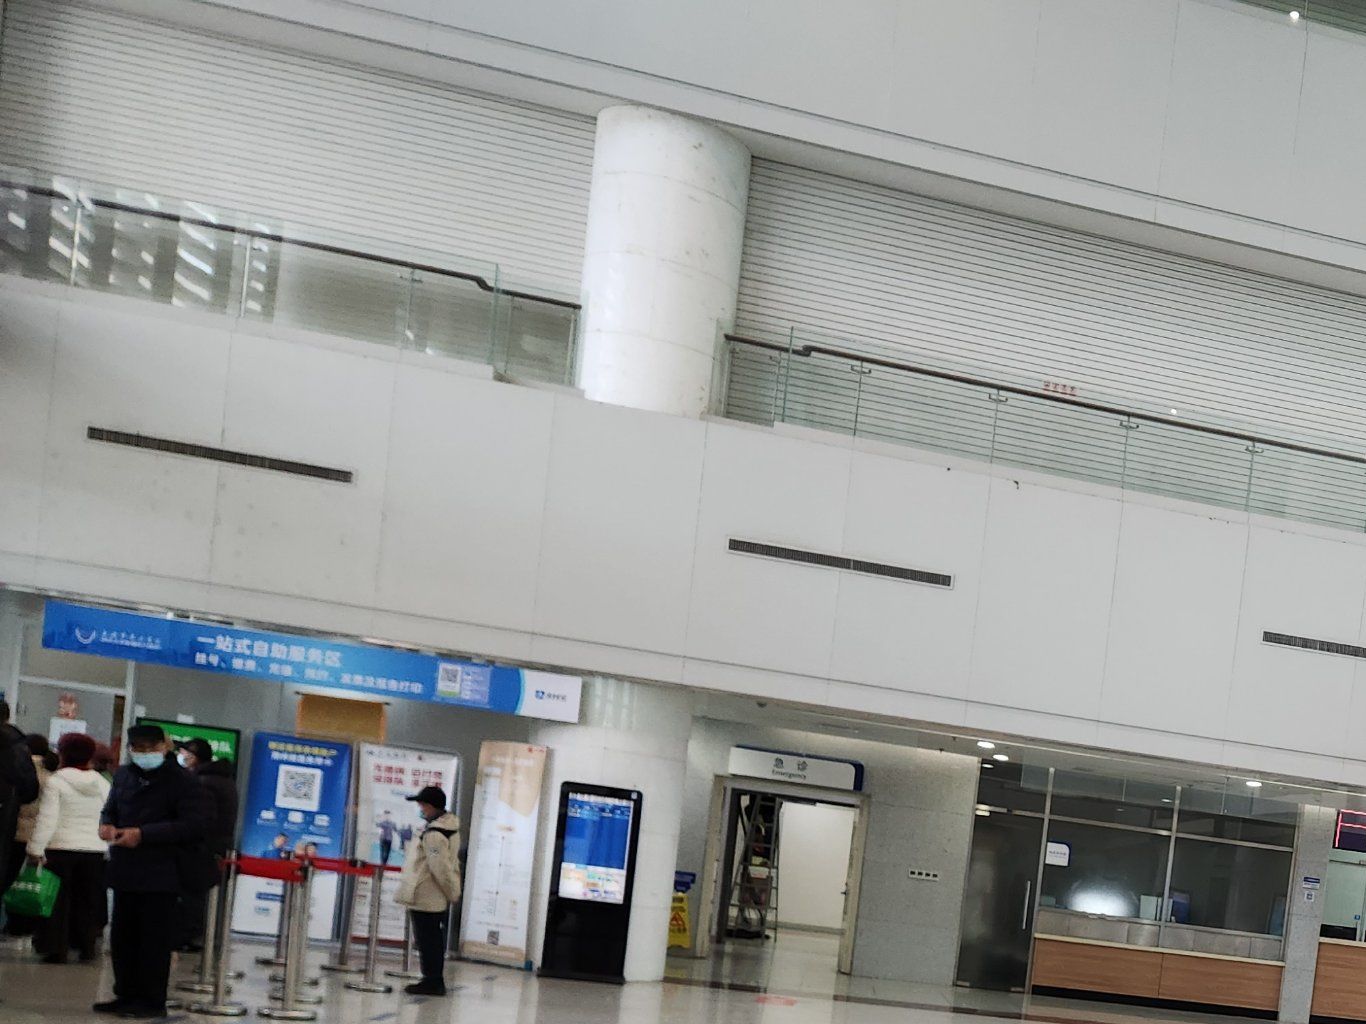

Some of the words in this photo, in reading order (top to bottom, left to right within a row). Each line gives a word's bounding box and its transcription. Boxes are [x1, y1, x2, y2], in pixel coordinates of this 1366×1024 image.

[197, 634, 341, 668] 一站式自助服务区
[773, 757, 808, 772] 急诊
[771, 769, 806, 780] Emergency
